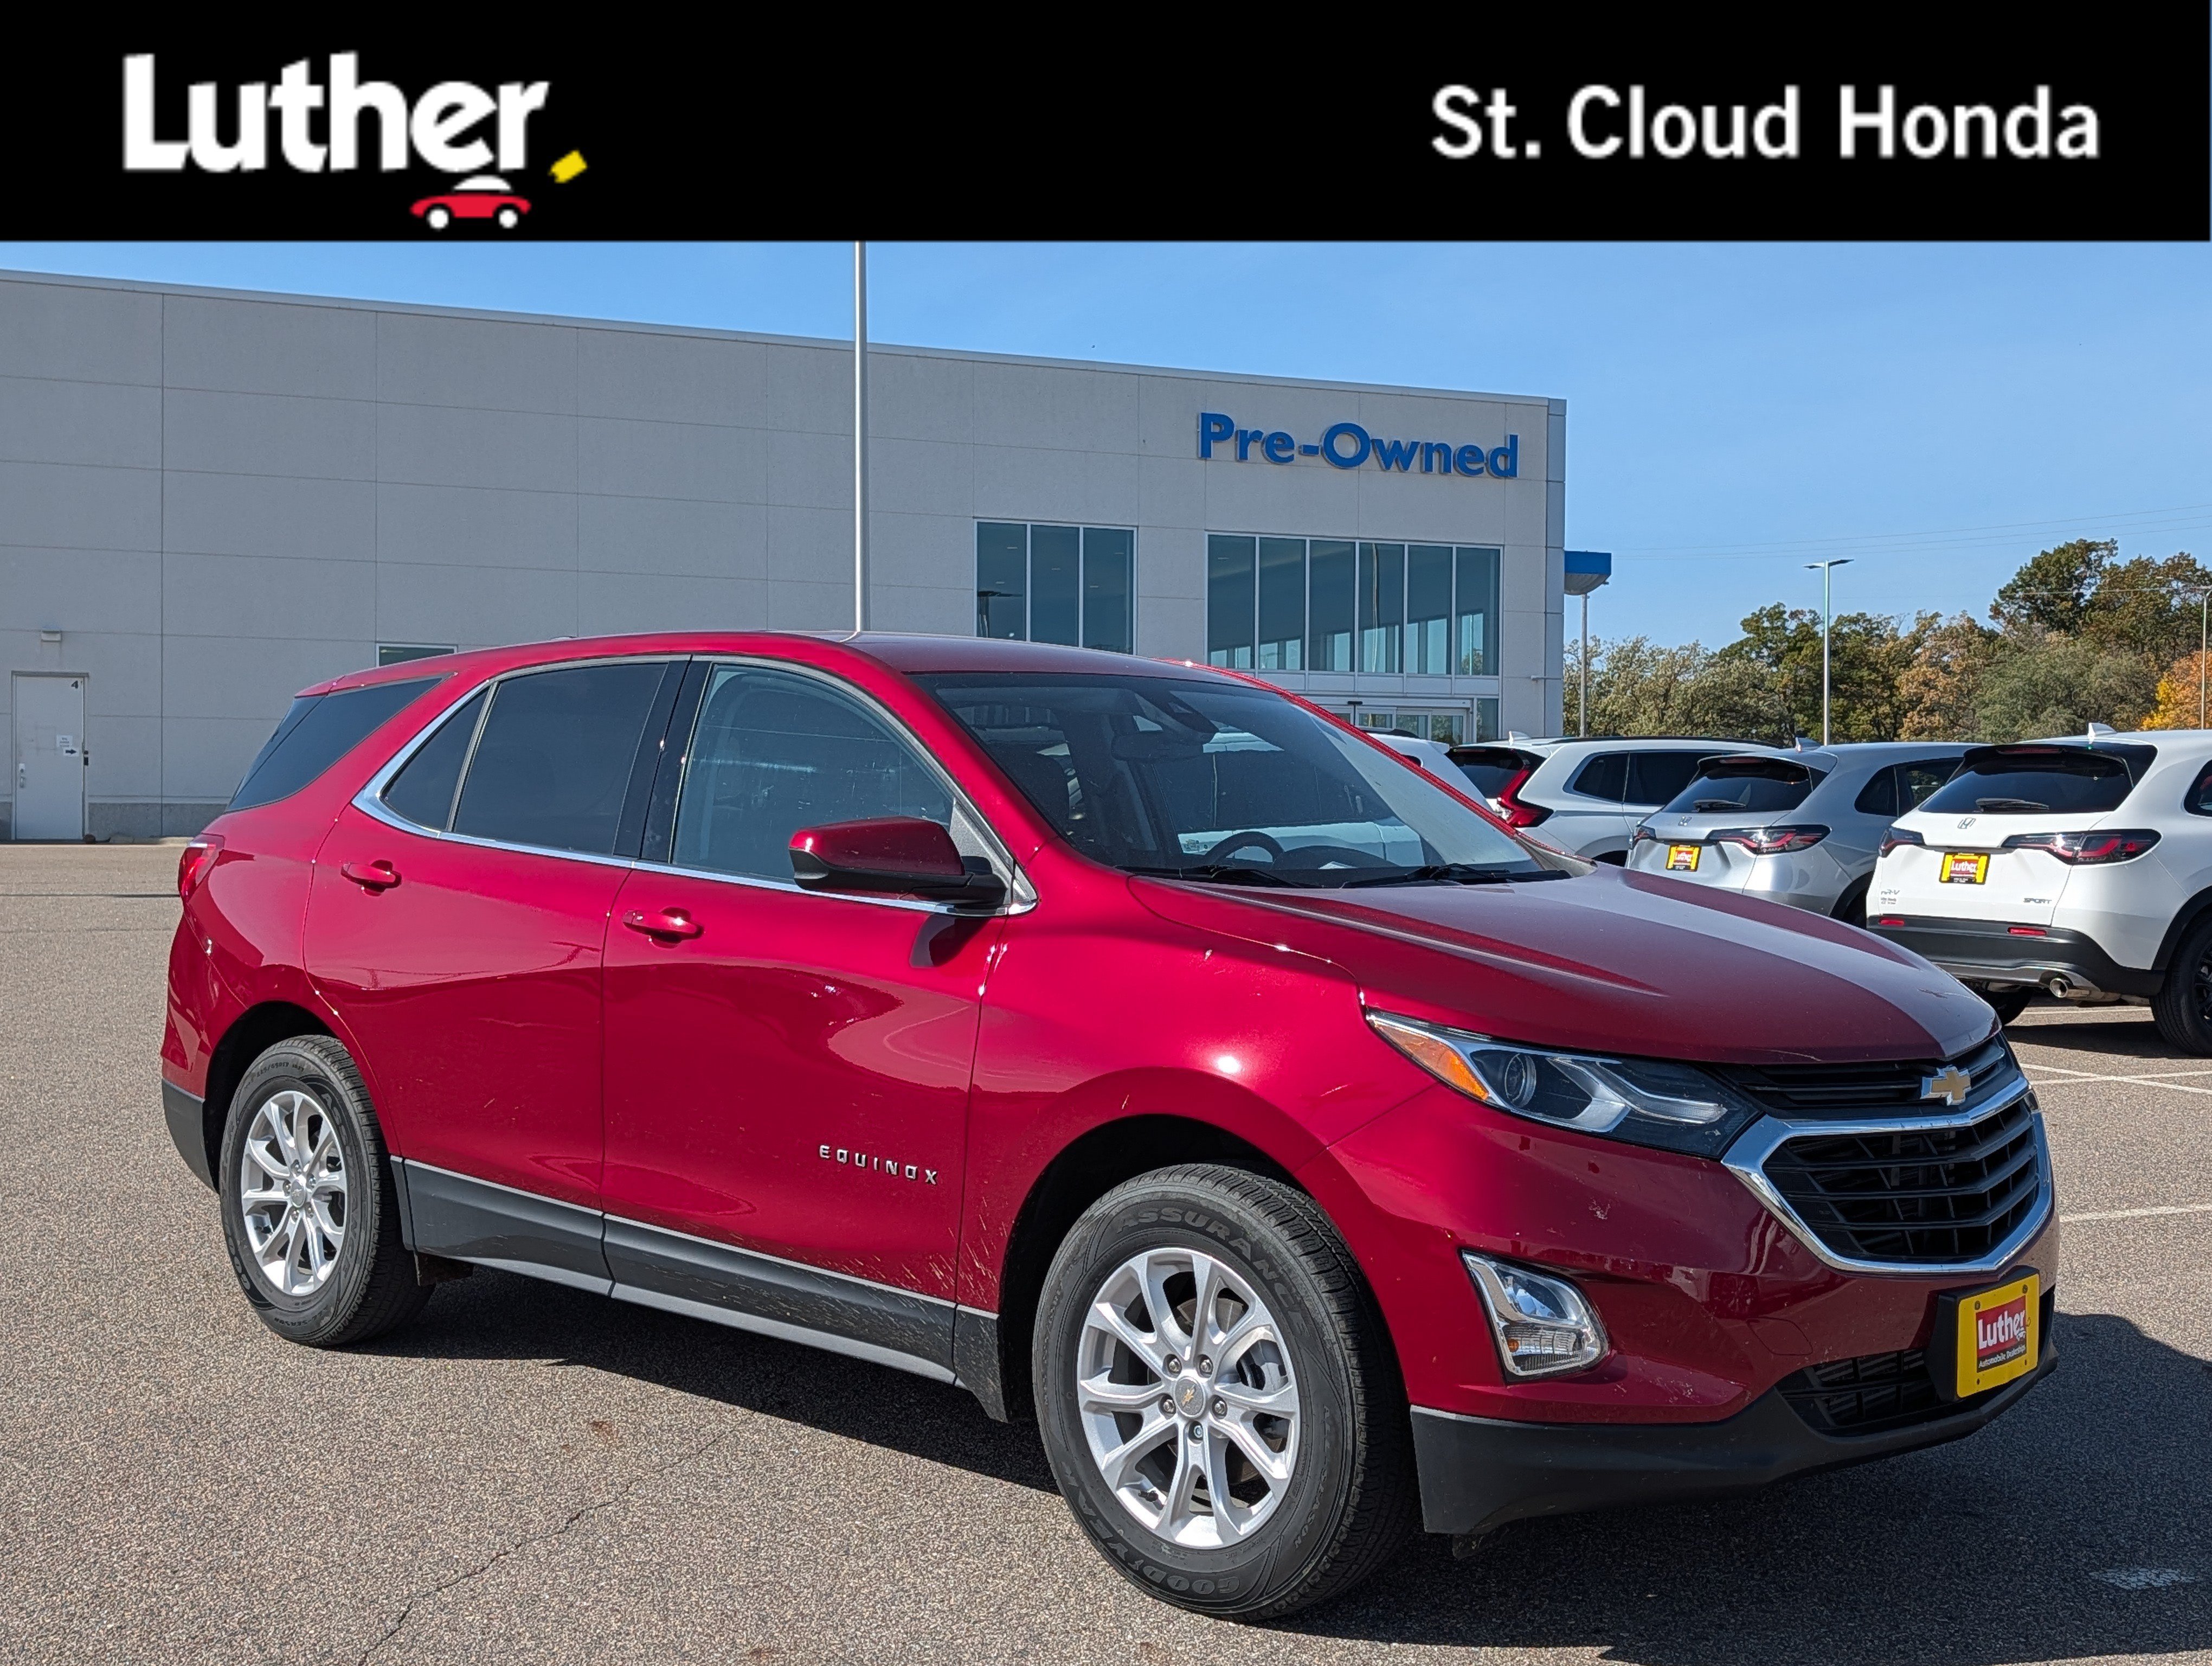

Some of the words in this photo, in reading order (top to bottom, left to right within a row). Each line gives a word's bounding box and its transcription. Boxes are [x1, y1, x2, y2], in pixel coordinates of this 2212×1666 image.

[1198, 412, 1519, 478] Pre-Owned
[819, 1144, 937, 1185] EQUINOX
[1116, 1207, 1310, 1335] ASSURANCE
[1978, 1310, 2025, 1350] Luther
[1293, 1404, 1332, 1549] ALL-SEASON
[1060, 1460, 1240, 1595] GOODYEAR
